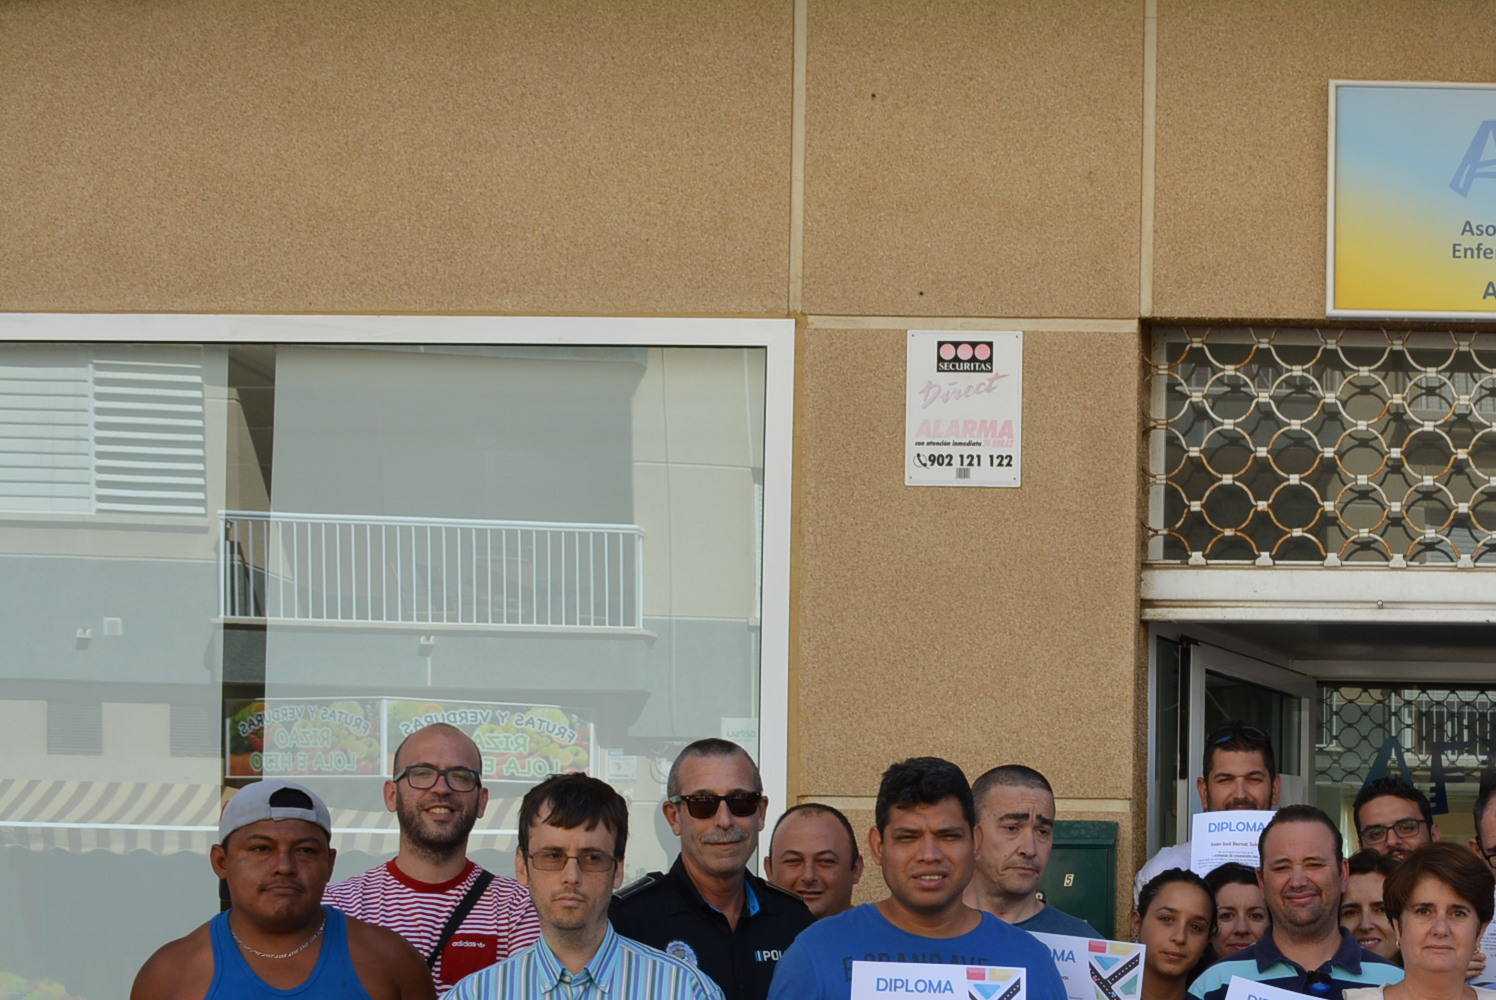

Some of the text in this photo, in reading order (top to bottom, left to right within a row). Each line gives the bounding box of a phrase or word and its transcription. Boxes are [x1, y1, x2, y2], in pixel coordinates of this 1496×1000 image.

[938, 362, 992, 371] SECURITAS
[918, 372, 1010, 409] Direct
[915, 419, 1014, 438] ALARMA
[928, 454, 1012, 467] 902 121 122
[1208, 822, 1265, 832] DIPLOMA
[876, 978, 954, 994] DIPLOMA
